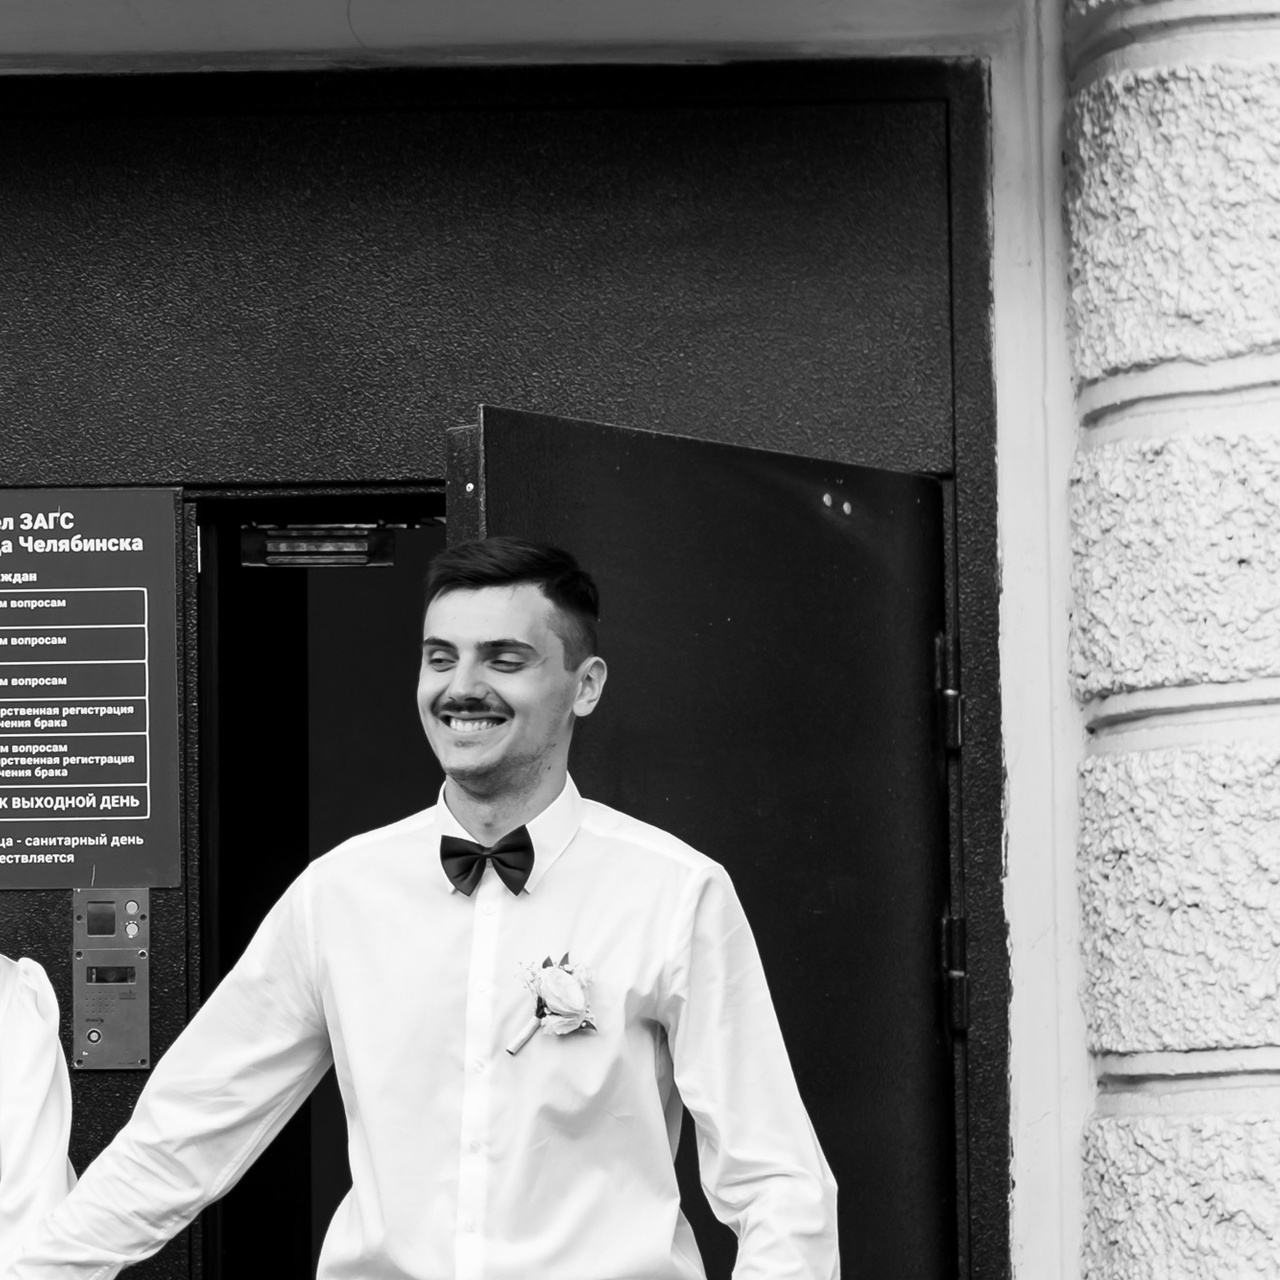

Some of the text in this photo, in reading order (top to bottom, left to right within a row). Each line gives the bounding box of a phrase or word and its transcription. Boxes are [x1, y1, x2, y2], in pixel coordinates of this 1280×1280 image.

[19, 512, 75, 531] ЗАГС
[18, 534, 144, 553] Челябинска
[10, 600, 67, 610] вопросам
[10, 637, 67, 648] вопросам
[10, 678, 68, 688] вопросам
[62, 706, 135, 717] регистрация
[33, 717, 68, 730] брака
[11, 745, 68, 755] вопросам
[62, 756, 135, 767] регистрация
[34, 767, 69, 779] брака
[11, 793, 97, 811] ВЫХОДНОЙ
[99, 796, 140, 811] ДЕНЬ
[24, 834, 108, 849] санитарный
[110, 836, 144, 848] день
